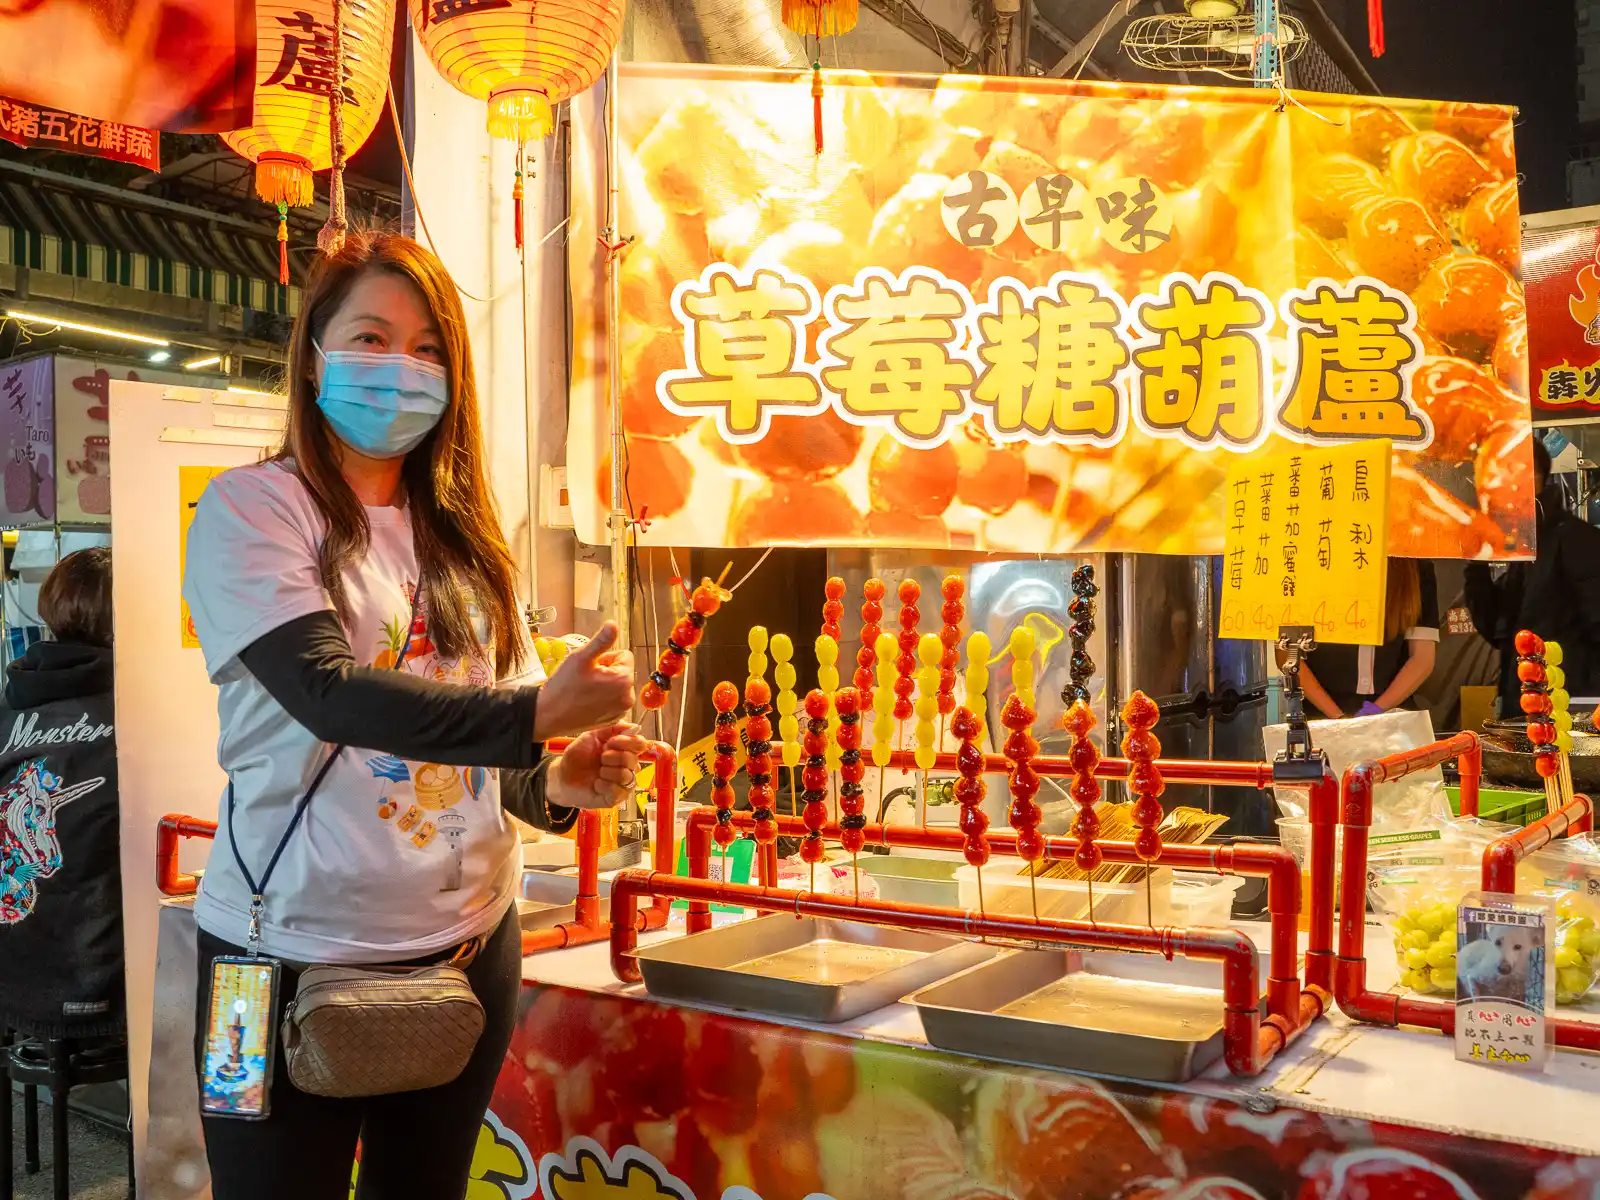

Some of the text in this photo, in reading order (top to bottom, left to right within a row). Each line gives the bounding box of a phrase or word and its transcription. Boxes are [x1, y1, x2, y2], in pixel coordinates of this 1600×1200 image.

[943, 170, 1171, 252] 古早味
[660, 266, 1430, 446] 草莓糖葫蘆
[26, 425, 49, 442] Taro
[1230, 477, 1250, 590] 草莓
[1317, 461, 1335, 570] 葡萄
[1223, 600, 1244, 631] 60
[1253, 605, 1274, 630] 40
[1314, 600, 1335, 632] 40
[1345, 600, 1366, 630] 40
[0, 712, 113, 755] Monster
[1409, 832, 1432, 840] GRAPES
